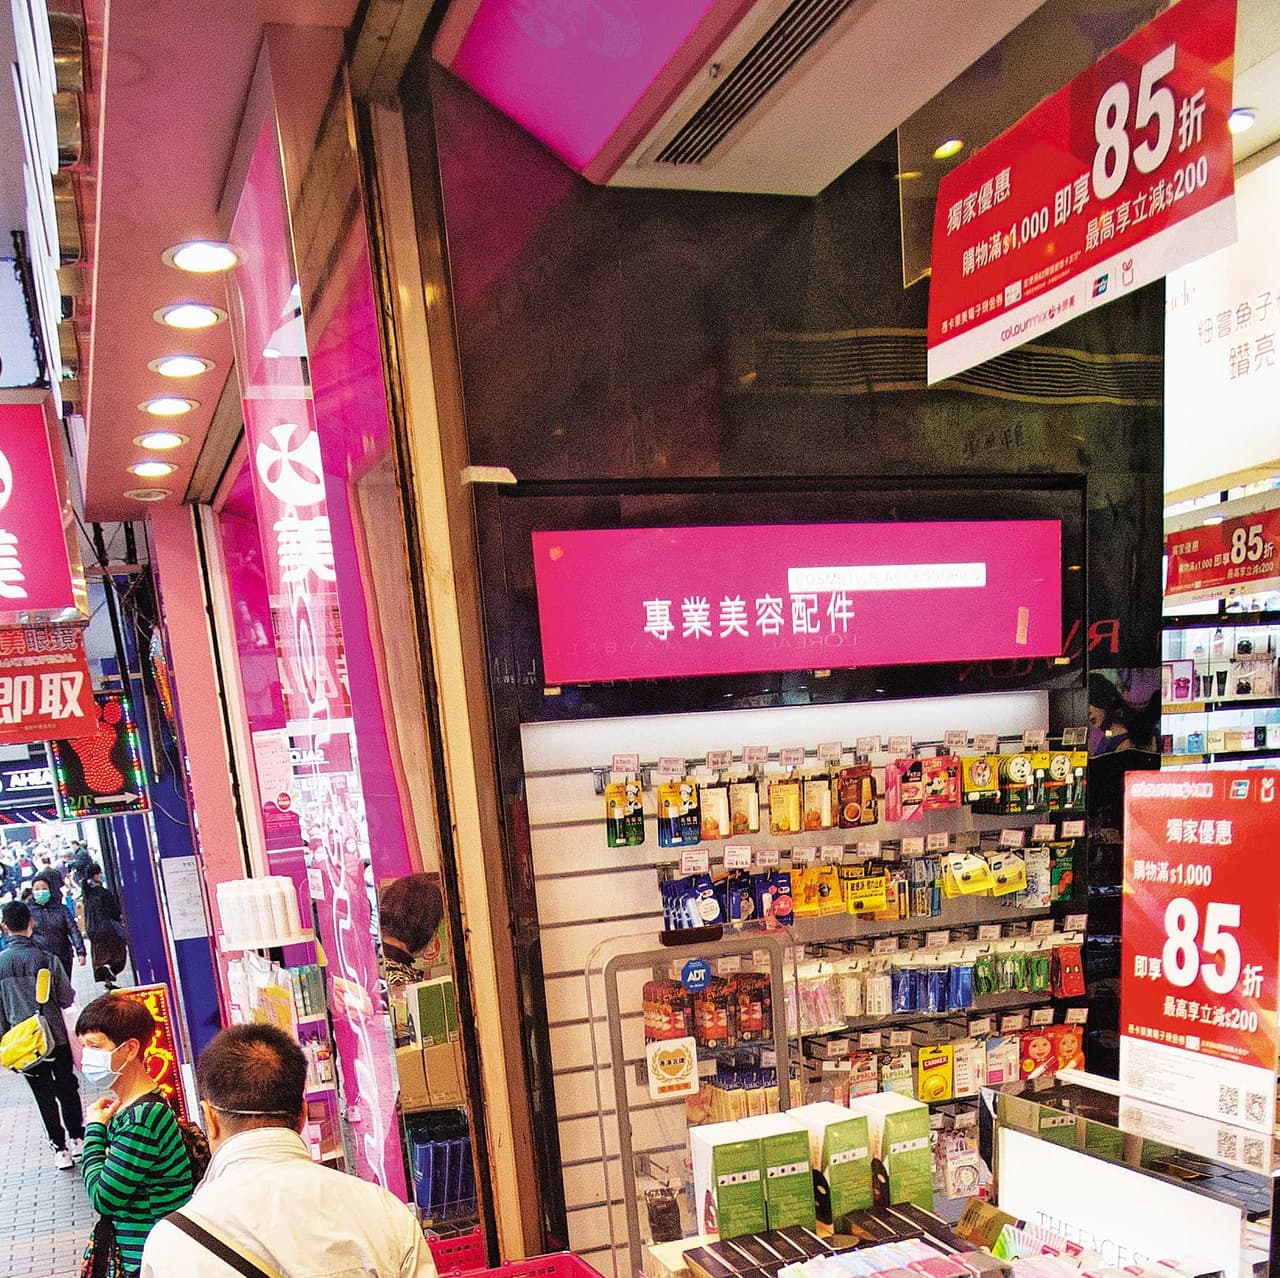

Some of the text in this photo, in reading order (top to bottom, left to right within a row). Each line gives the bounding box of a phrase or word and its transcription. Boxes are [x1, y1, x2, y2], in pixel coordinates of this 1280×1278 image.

[1091, 44, 1177, 200] 85
[1177, 87, 1207, 155] 折
[946, 166, 1012, 237] 獨家優惠
[1053, 171, 1092, 230] 即享
[1084, 154, 1209, 252] 最高享立減$200
[1230, 524, 1264, 565] 85
[642, 592, 856, 642] 專業美容配件
[1166, 818, 1233, 846] 獨家優惠
[1133, 860, 1213, 887] 購物滿$1,000
[1133, 954, 1162, 981] 即享
[1160, 896, 1242, 995] 85
[687, 973, 706, 983] ADT
[1242, 963, 1265, 999] 折
[1163, 994, 1259, 1034] 最高享立減$200
